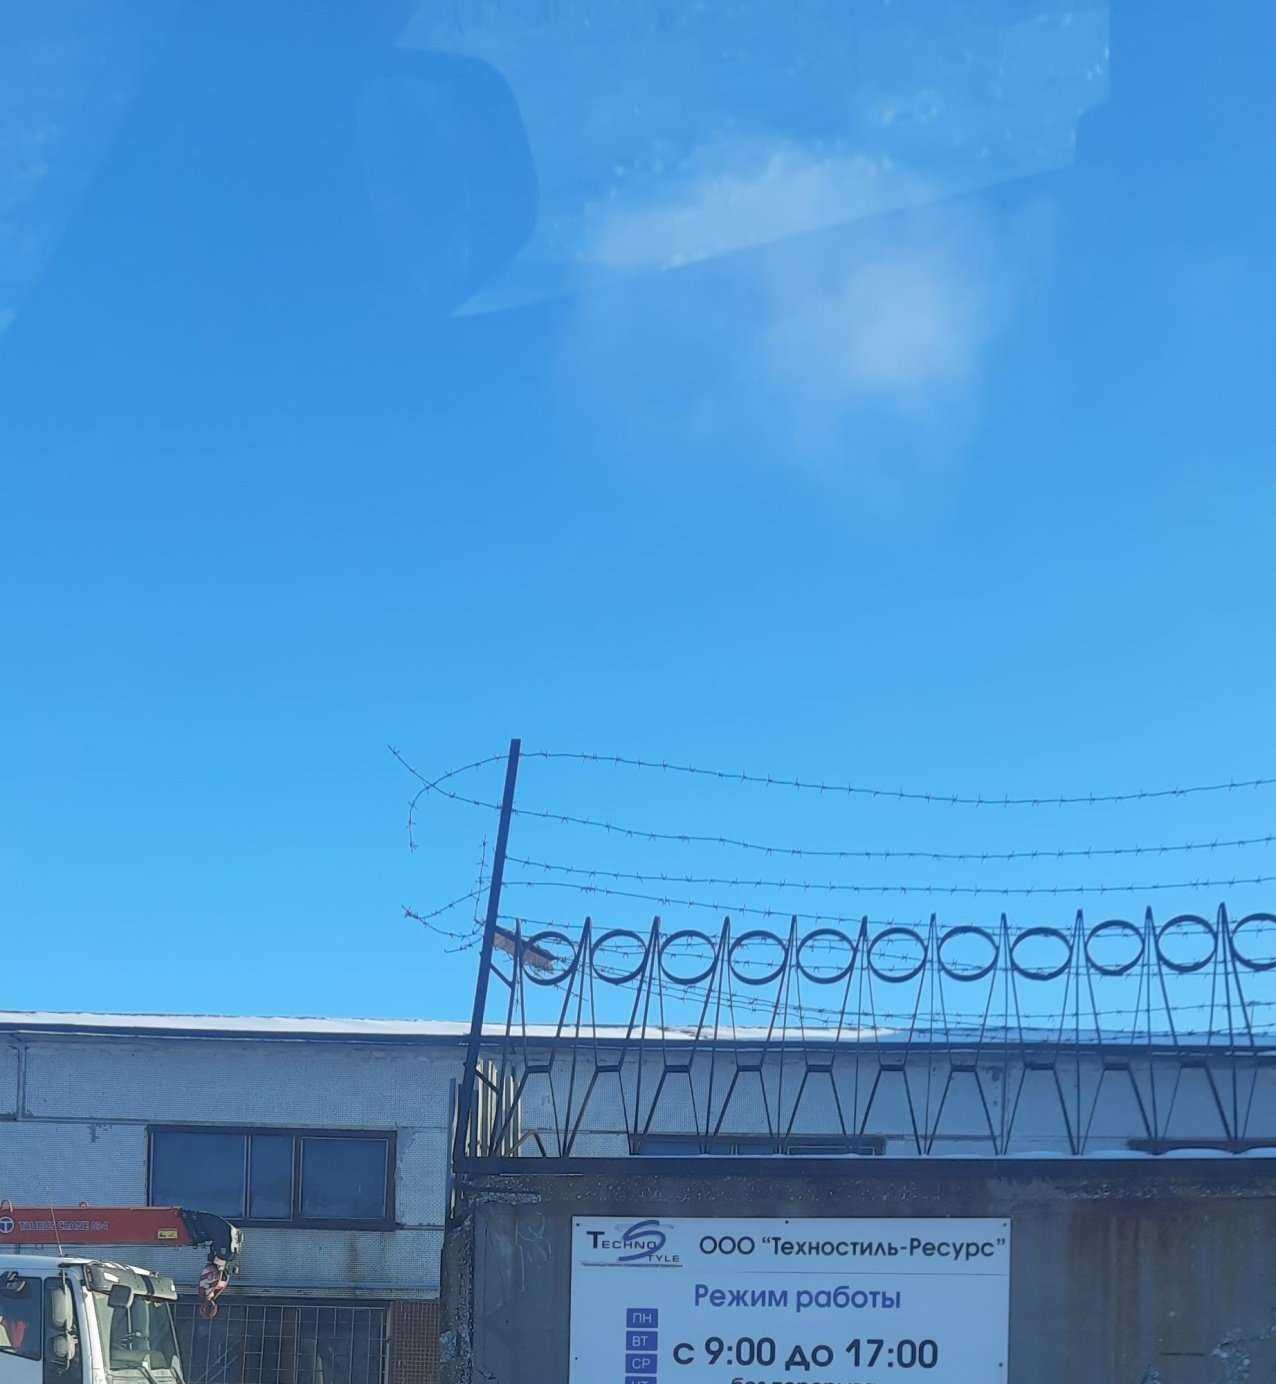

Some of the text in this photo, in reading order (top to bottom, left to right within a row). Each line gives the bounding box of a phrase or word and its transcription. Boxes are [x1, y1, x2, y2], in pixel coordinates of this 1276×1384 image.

[699, 1235, 755, 1255] ООО
[694, 1283, 901, 1313] Режим работы
[632, 1311, 653, 1325] ПН
[631, 1334, 648, 1348] ВТ
[704, 1336, 776, 1367] 9:00
[785, 1344, 834, 1371] до
[846, 1338, 939, 1369] 17:00
[631, 1357, 651, 1371] СР
